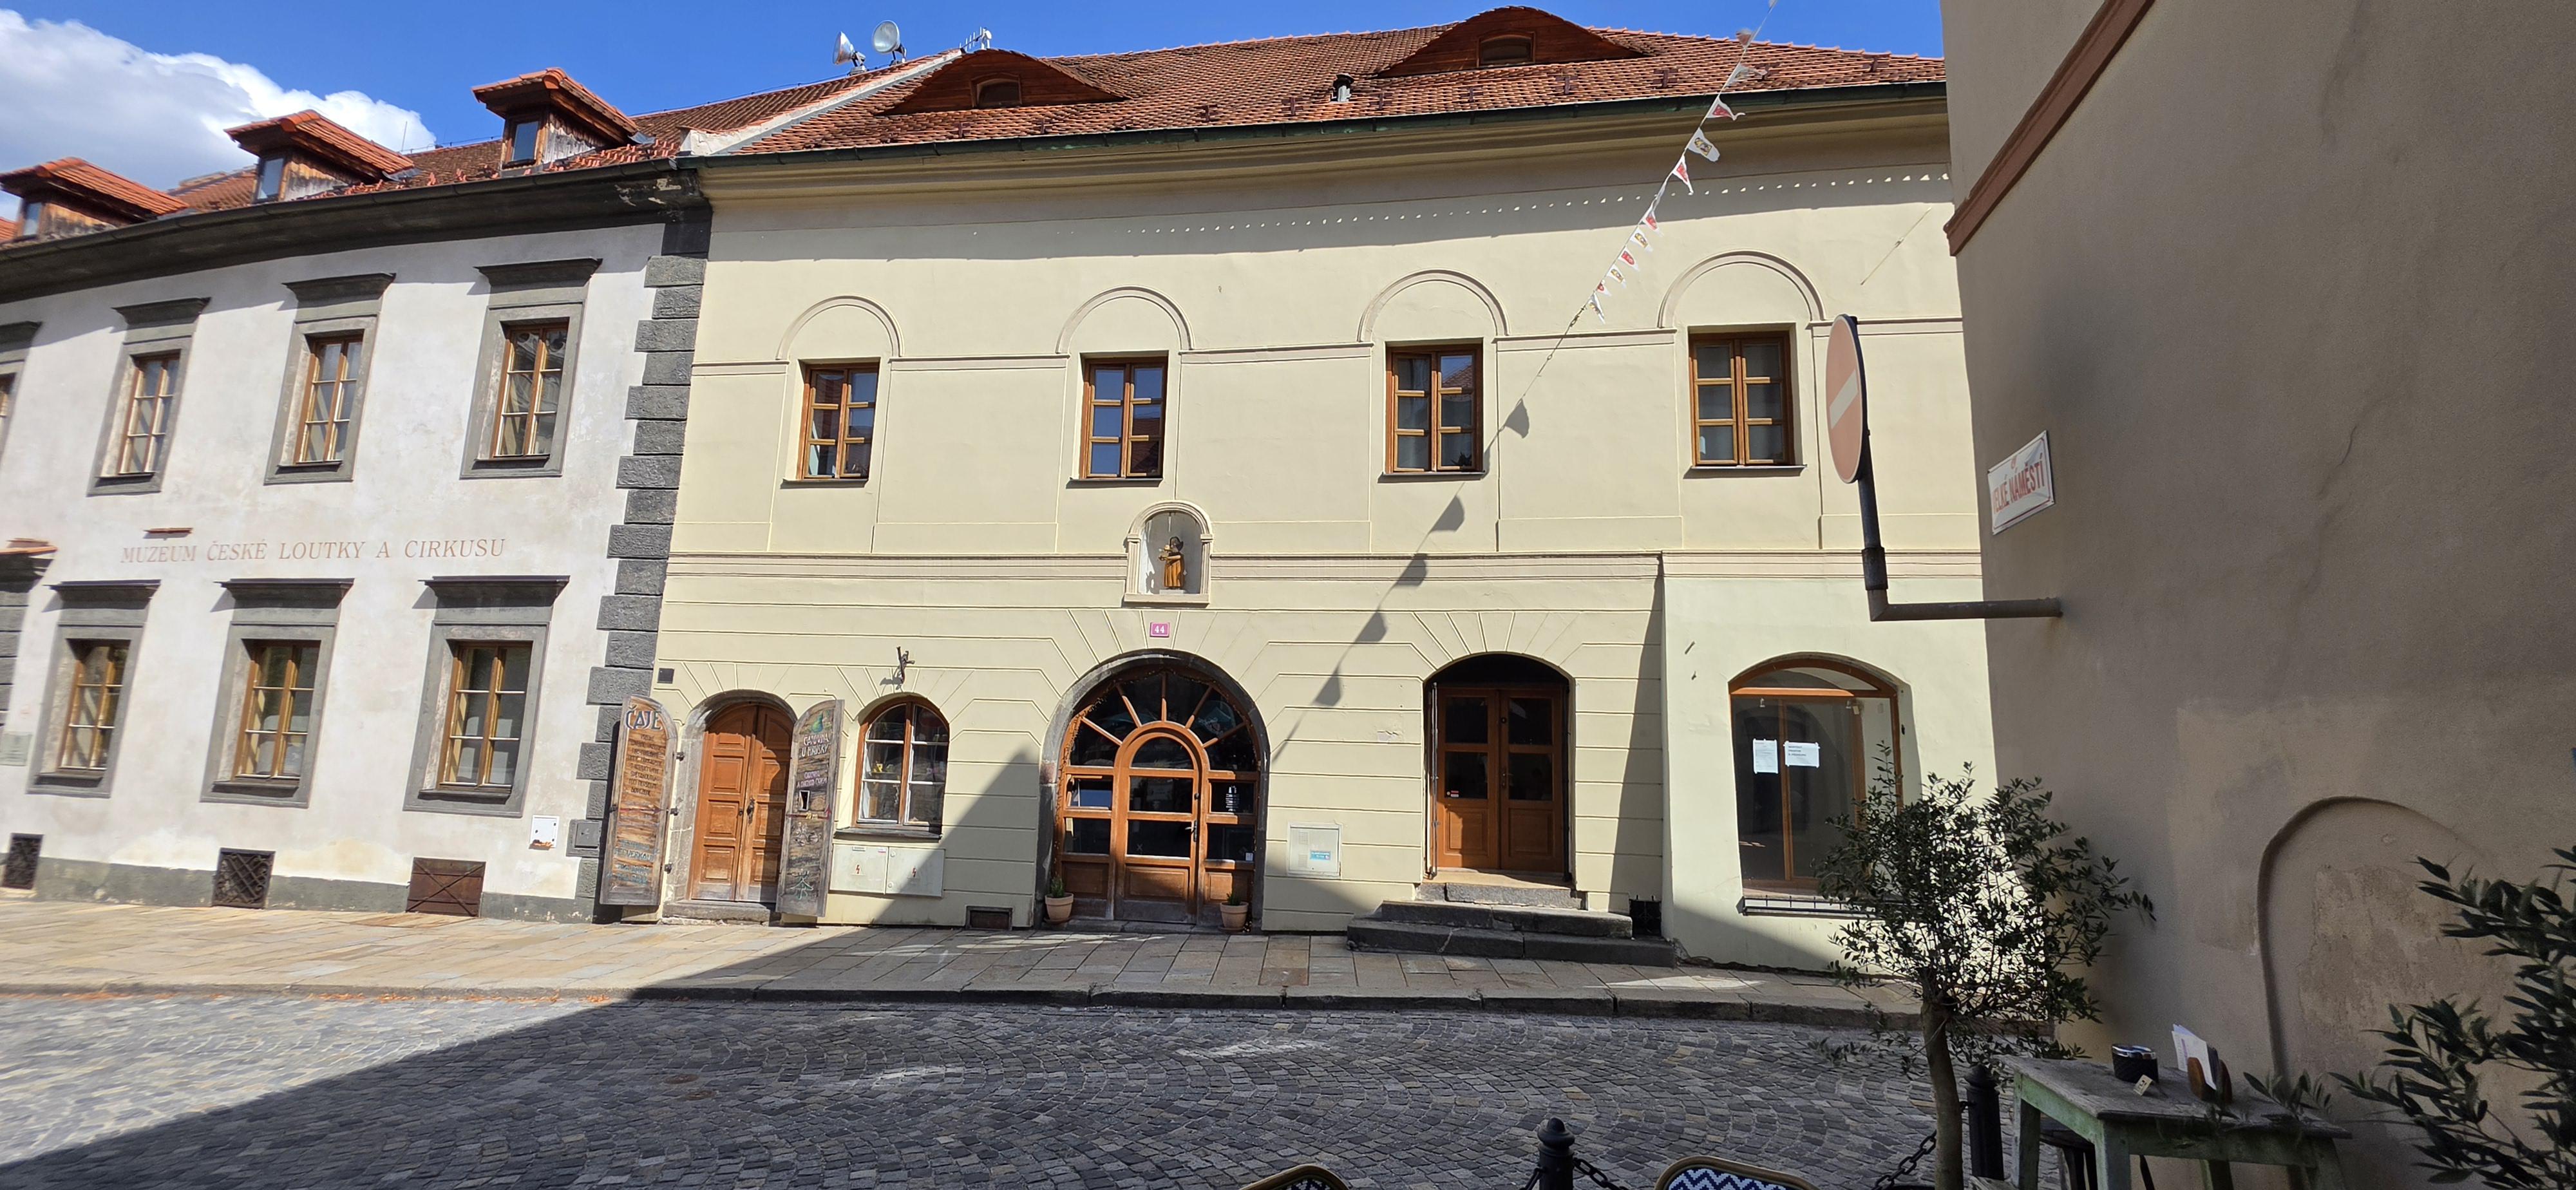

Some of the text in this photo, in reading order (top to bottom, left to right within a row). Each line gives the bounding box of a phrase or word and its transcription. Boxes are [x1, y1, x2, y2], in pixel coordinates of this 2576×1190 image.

[1993, 453, 2045, 514] ELKÉ NÁMĚSTÍ
[120, 538, 506, 563] MUZEUM ČESKÉ LOUTKY A CIRKUSU
[1154, 625, 1165, 634] 44
[625, 704, 663, 730] ČAJE
